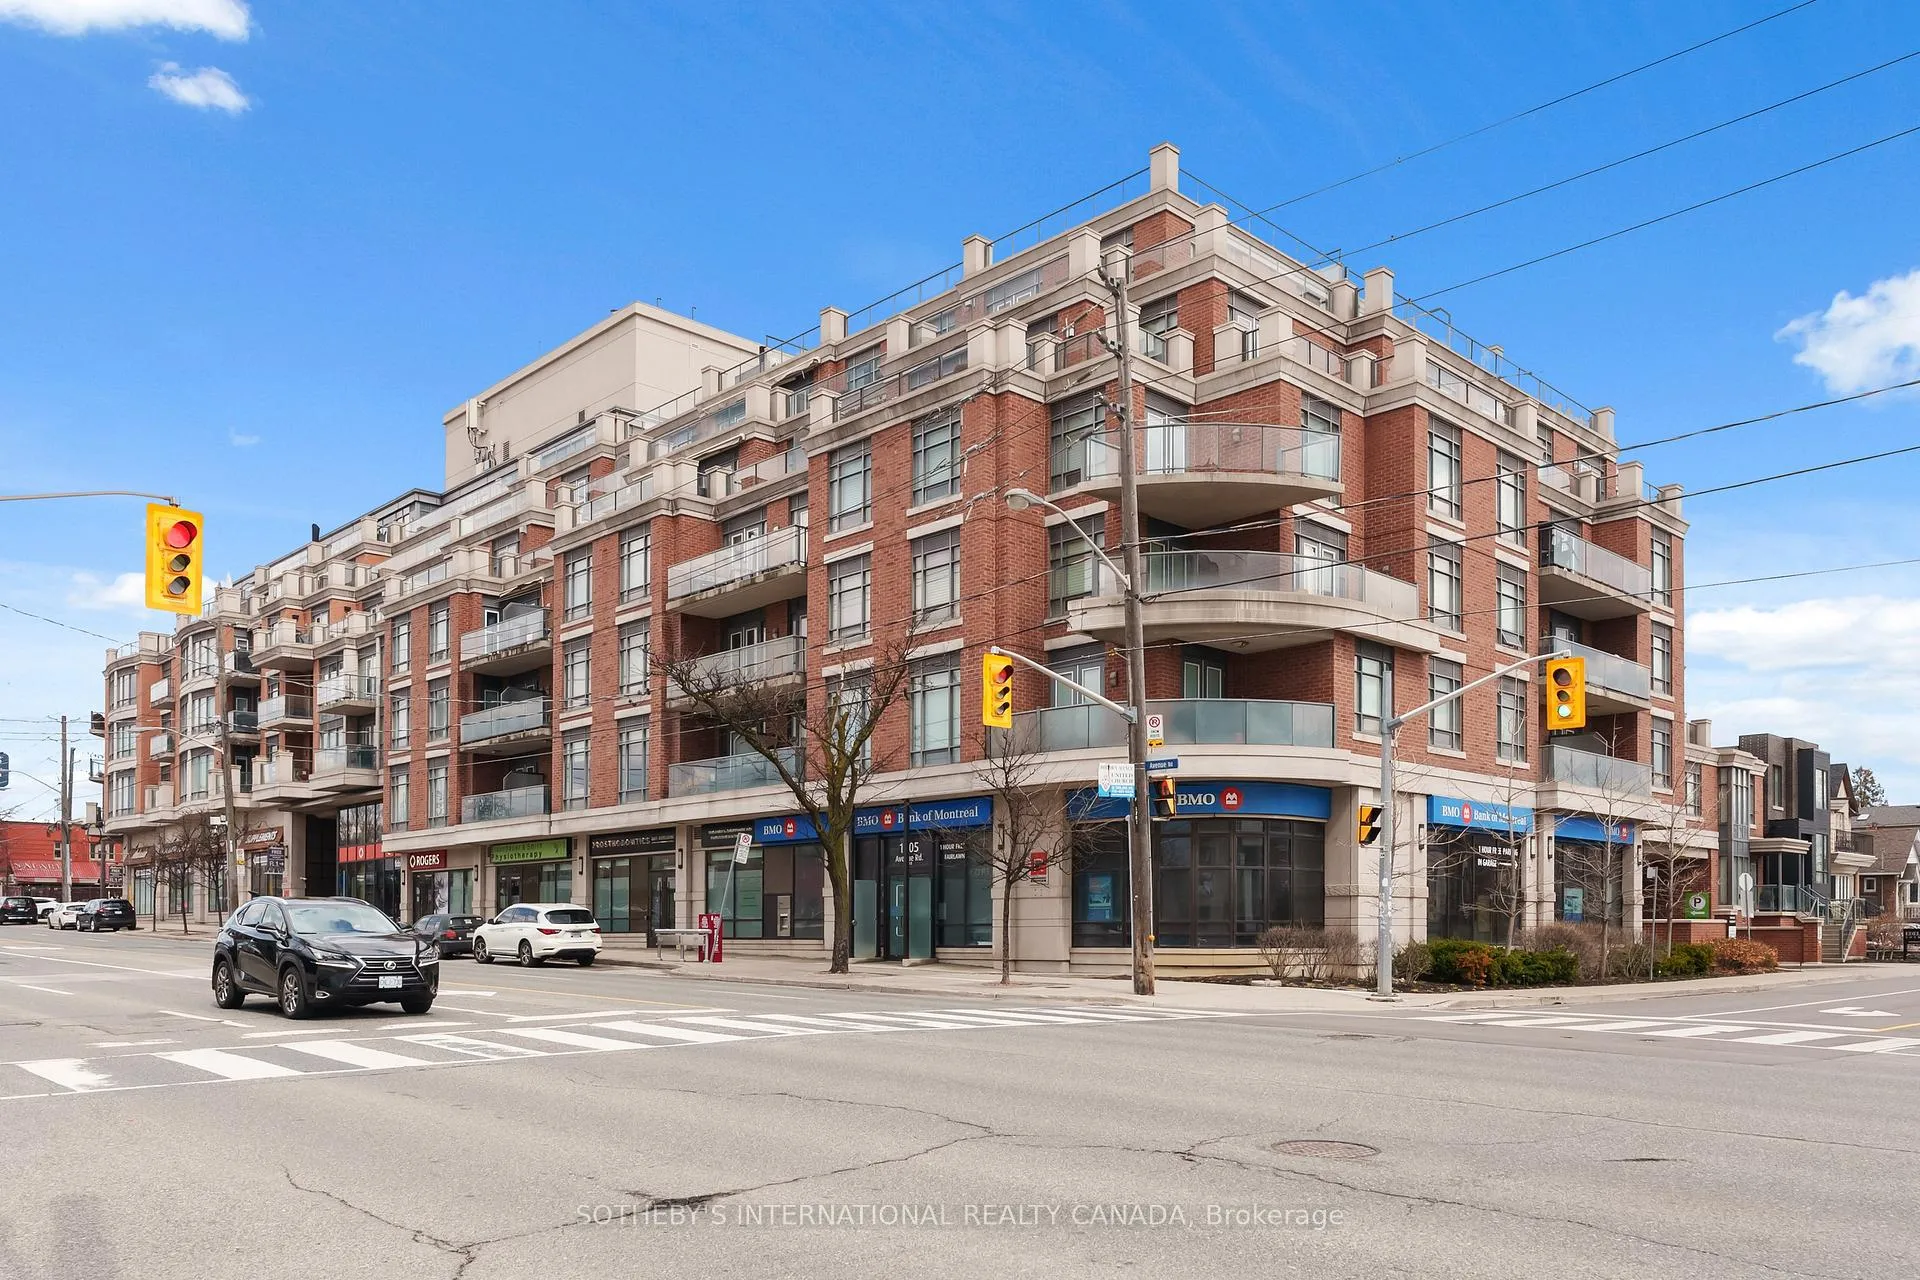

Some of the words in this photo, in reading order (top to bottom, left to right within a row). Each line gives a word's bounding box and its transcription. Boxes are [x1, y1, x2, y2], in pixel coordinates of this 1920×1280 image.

[1149, 761, 1167, 769] Avenue
[1177, 792, 1216, 806] BMO
[857, 815, 879, 826] BMO
[897, 811, 922, 823] Bnk
[923, 809, 933, 821] of
[934, 806, 978, 820] Montreal
[1442, 805, 1460, 817] BMO
[1474, 810, 1490, 822] Bank
[763, 824, 783, 835] BMO
[591, 836, 651, 849] PROSTHODONTICS
[899, 841, 920, 854] 105
[1481, 845, 1492, 854] HOUR
[416, 853, 440, 867] ROGERS
[1483, 858, 1498, 868] GARAGE
[1693, 897, 1702, 907] P
